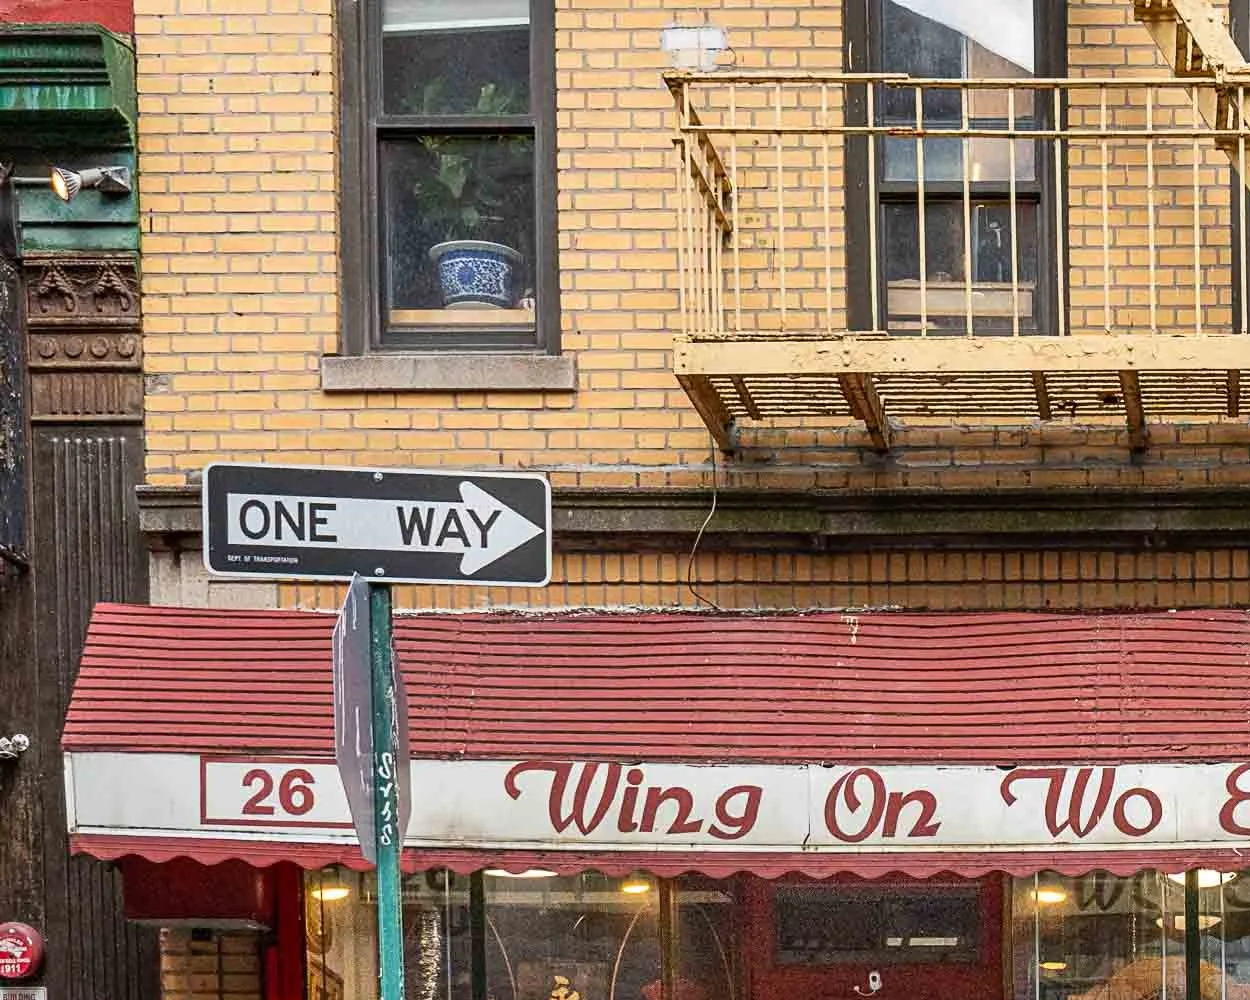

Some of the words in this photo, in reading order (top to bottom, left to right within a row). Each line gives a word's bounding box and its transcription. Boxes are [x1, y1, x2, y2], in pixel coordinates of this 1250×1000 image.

[239, 499, 338, 543] ONE
[397, 506, 502, 548] WAY
[241, 767, 315, 817] 26
[504, 760, 763, 841] Wing
[824, 767, 942, 843] On
[1000, 767, 1163, 838] Wo
[2, 993, 36, 1000] BUILDING
